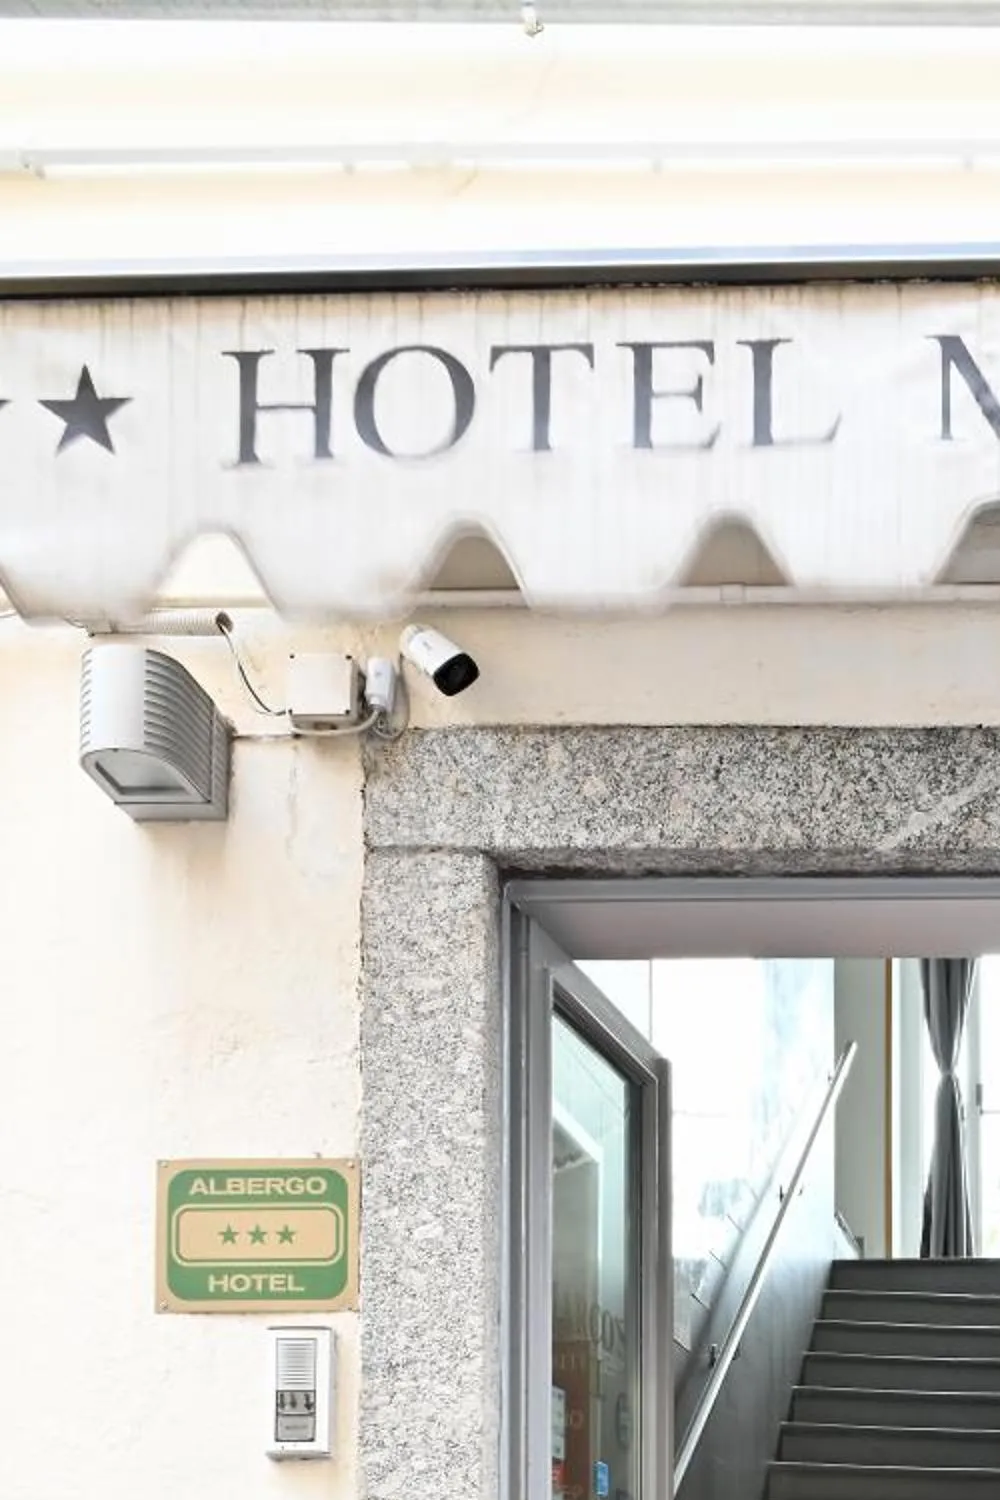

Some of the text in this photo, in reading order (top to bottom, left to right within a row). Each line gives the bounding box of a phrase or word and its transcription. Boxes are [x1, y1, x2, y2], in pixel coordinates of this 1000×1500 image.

[221, 337, 842, 470] HOTEL
[188, 1176, 328, 1196] ALBERGO
[207, 1274, 305, 1294] HOTEL
